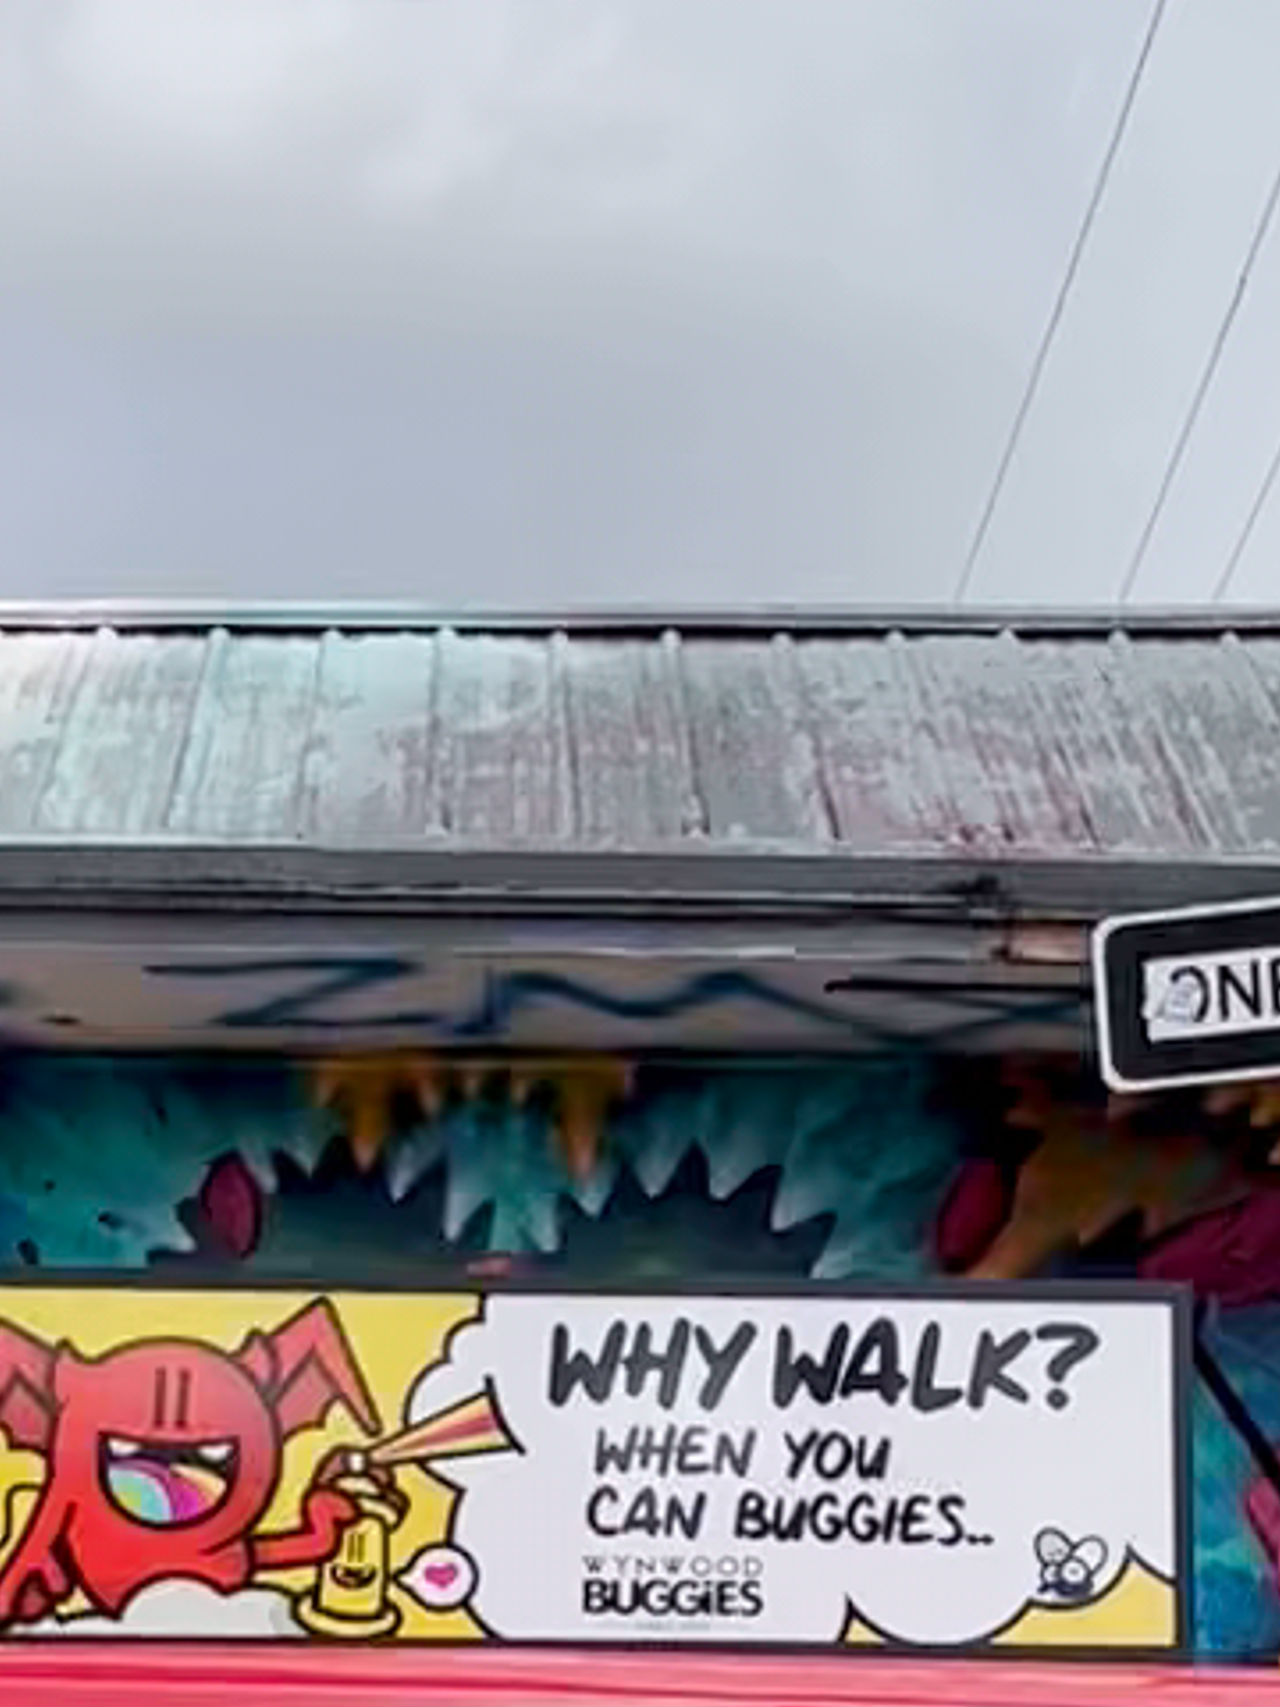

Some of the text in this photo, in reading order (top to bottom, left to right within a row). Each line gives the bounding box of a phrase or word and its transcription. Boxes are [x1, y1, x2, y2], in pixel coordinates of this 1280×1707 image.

[548, 1316, 1101, 1413] WHY WALK?
[594, 1423, 892, 1481] WHEN YOU
[586, 1484, 707, 1540] CAN
[581, 1555, 764, 1578] WYNWOOD
